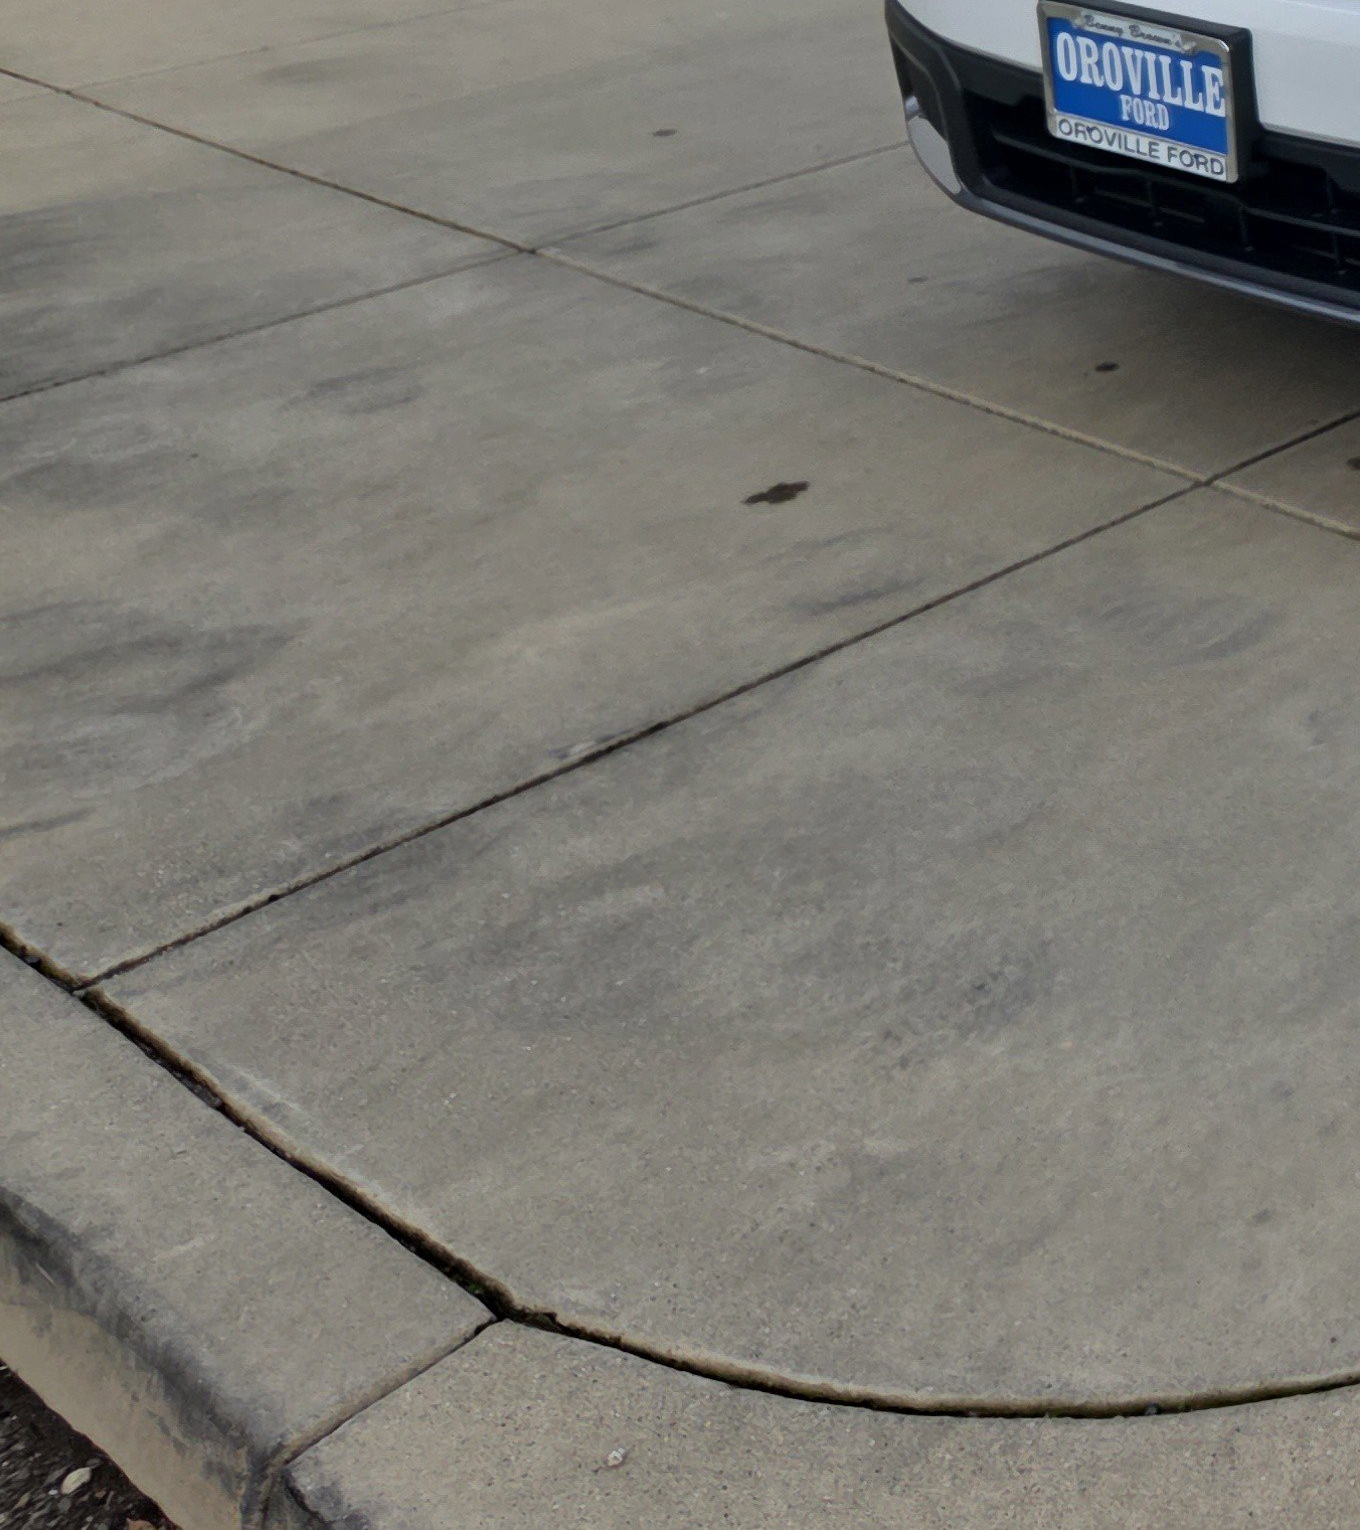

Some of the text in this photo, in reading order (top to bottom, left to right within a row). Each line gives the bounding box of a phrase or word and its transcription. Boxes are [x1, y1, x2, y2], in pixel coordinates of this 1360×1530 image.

[1056, 31, 1226, 118] OROVILLE
[1119, 93, 1170, 131] FORD
[1058, 118, 1224, 176] OROVILLE FORD
